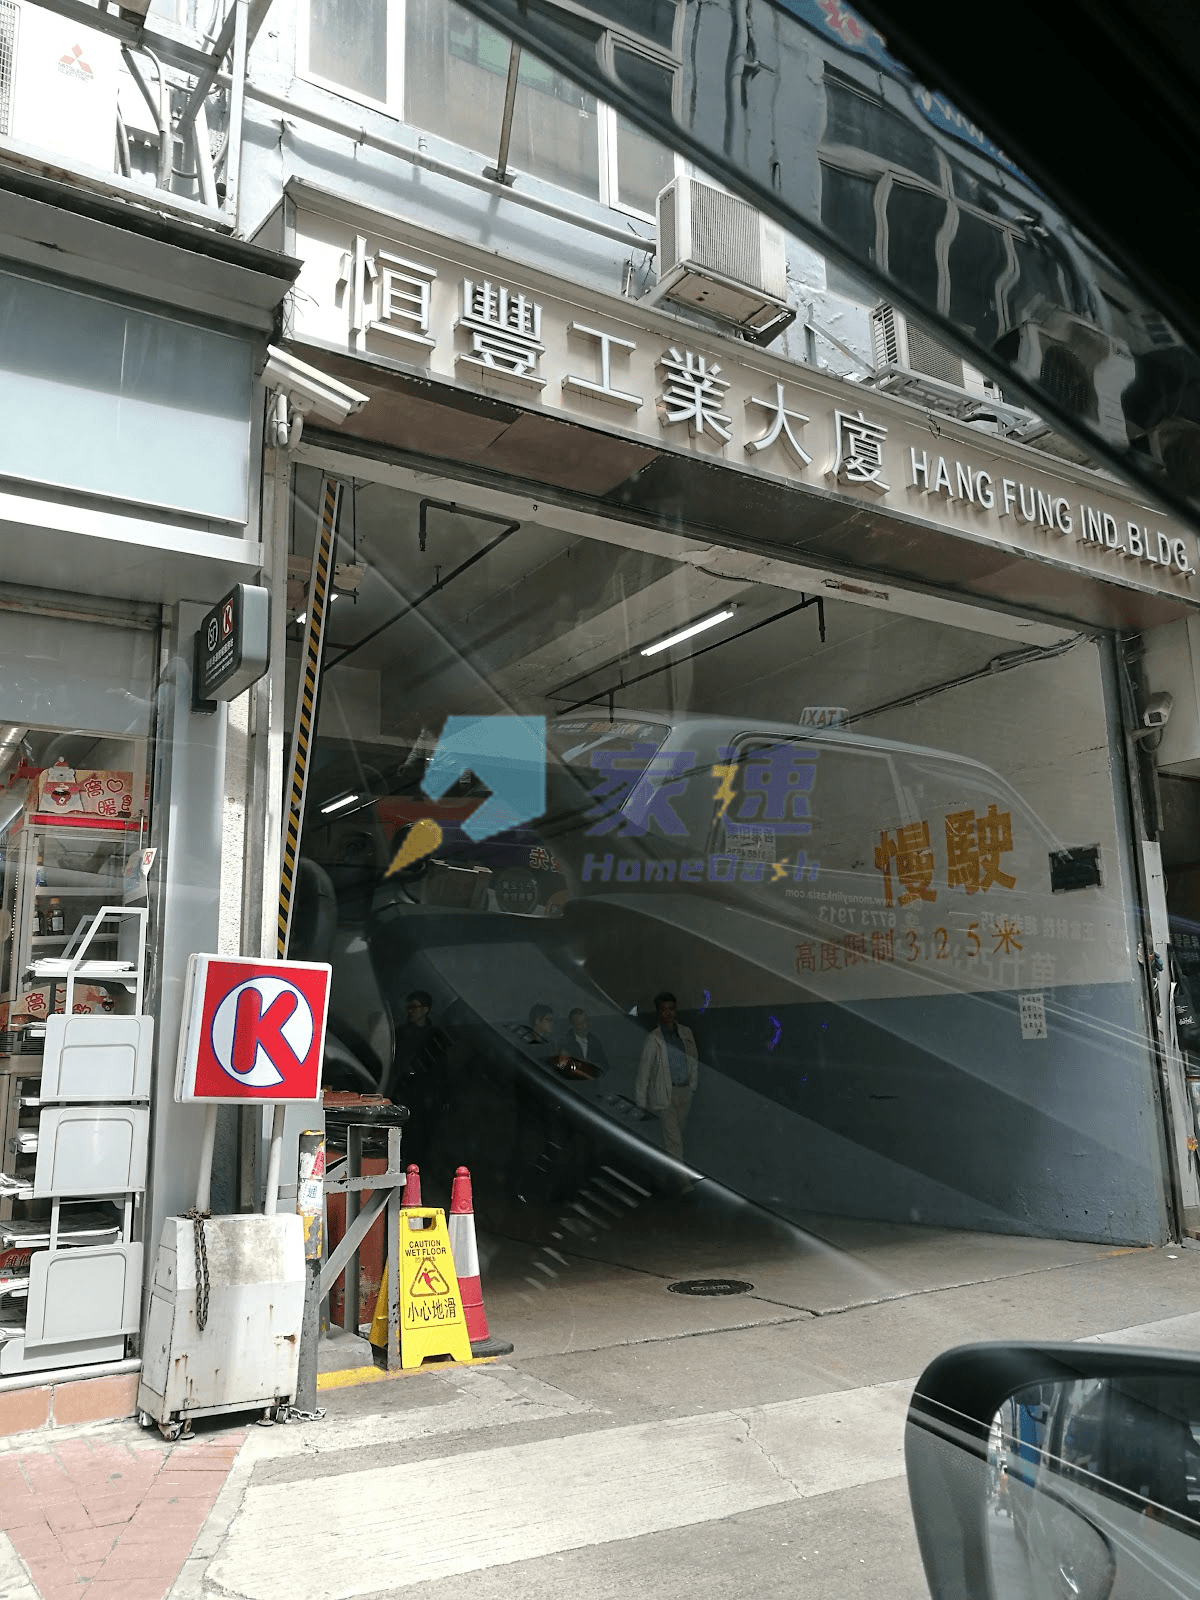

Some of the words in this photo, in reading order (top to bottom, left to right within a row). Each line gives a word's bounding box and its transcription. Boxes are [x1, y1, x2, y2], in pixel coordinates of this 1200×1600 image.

[338, 234, 890, 494] 恒豐工業大廈
[907, 446, 995, 509] HANG
[1000, 478, 1073, 534] FUNG
[874, 804, 1017, 908] 慢駛
[228, 984, 304, 1084] K
[404, 1248, 421, 1257] WET
[421, 1246, 447, 1256] FLOOR
[408, 1239, 441, 1249] CAUTION
[407, 1297, 457, 1323] 小心地滑
